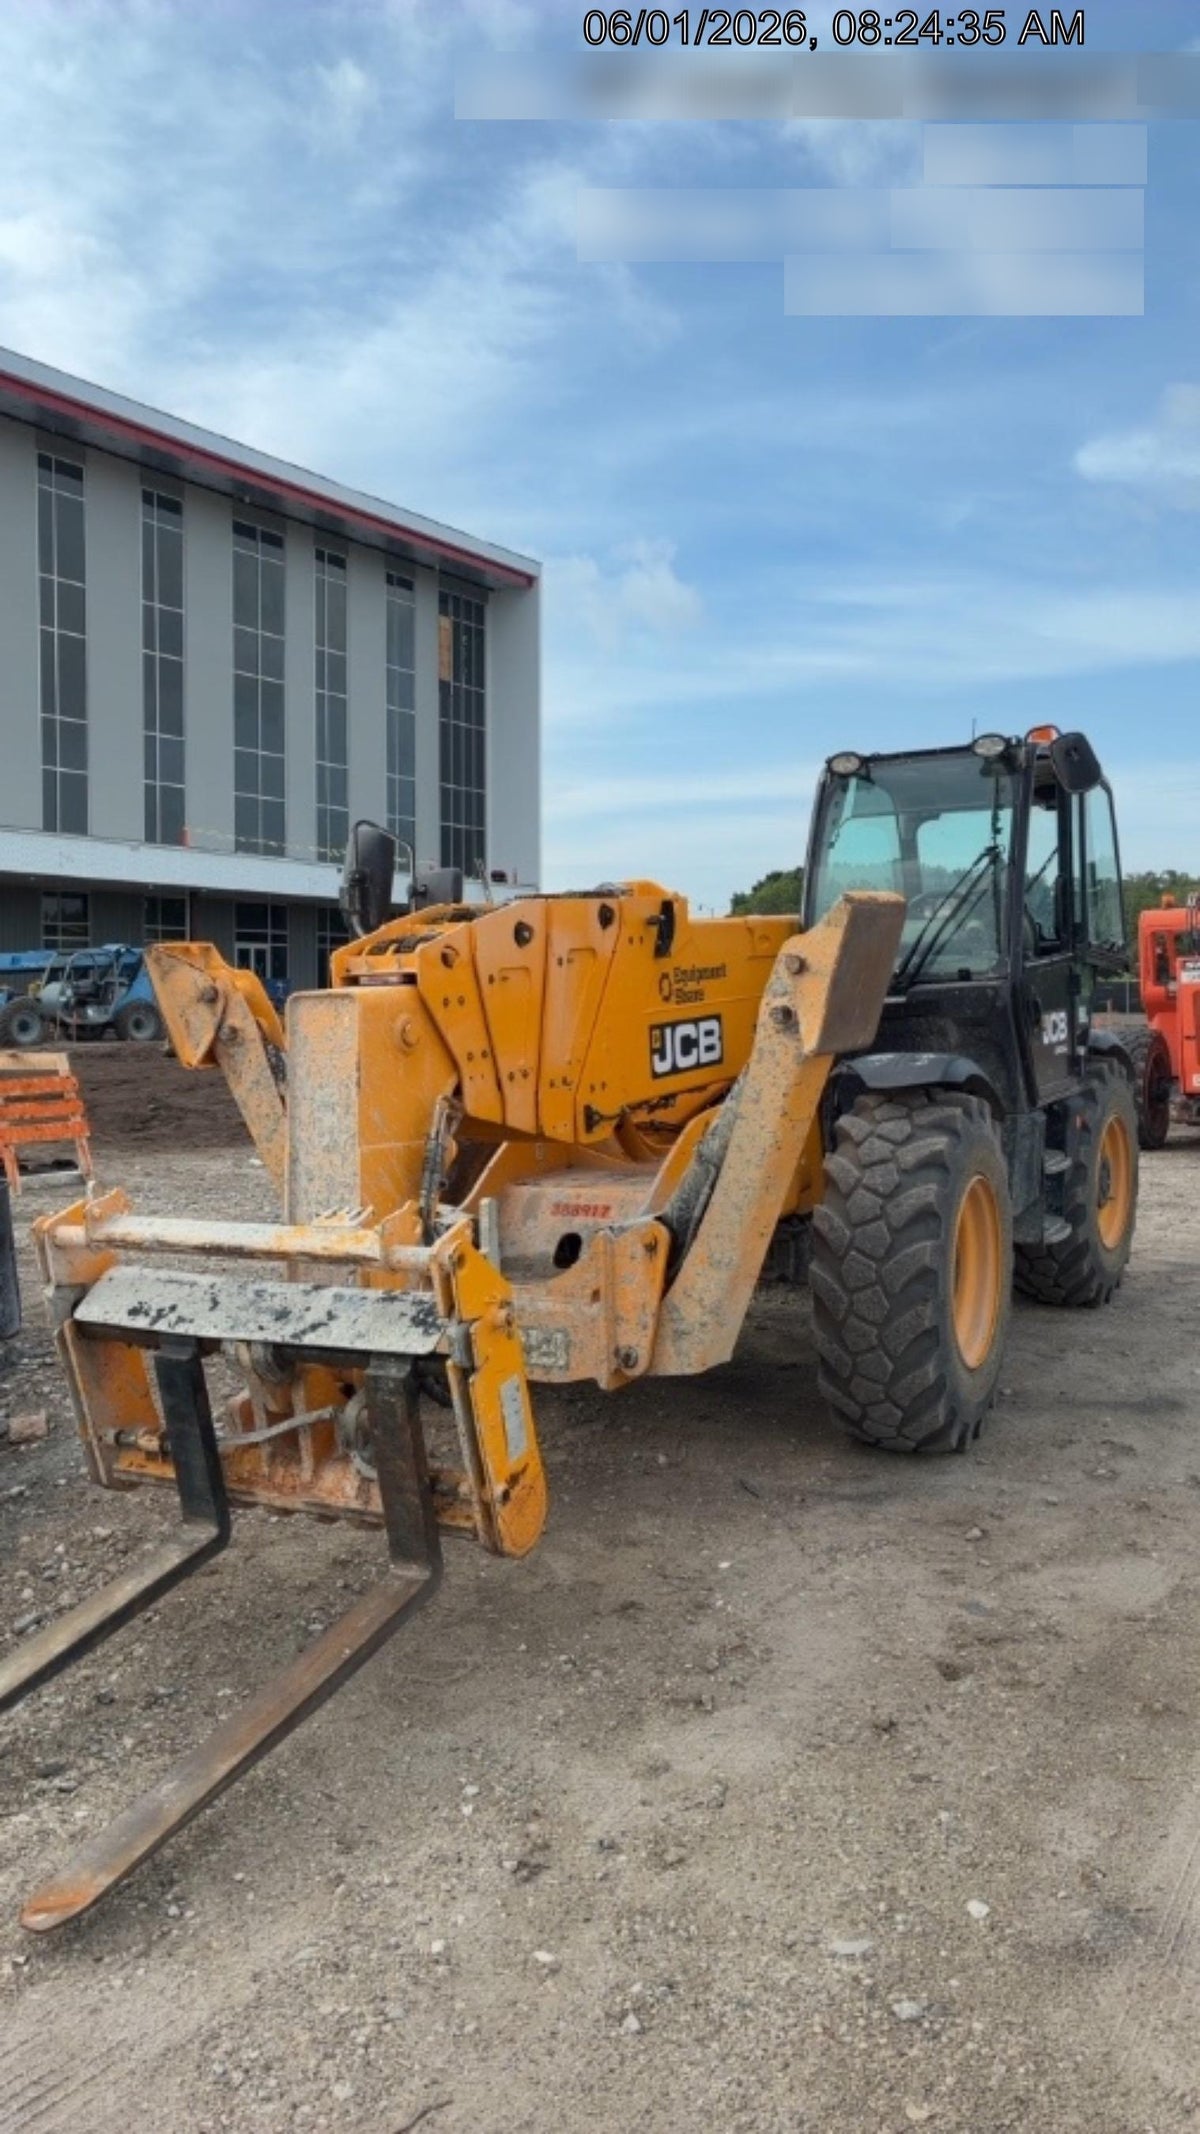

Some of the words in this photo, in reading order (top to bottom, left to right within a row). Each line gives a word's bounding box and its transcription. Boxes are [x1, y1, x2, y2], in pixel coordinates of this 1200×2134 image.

[673, 963, 727, 987] Equipment
[1042, 1012, 1068, 1045] JCB
[652, 1018, 721, 1075] JCB
